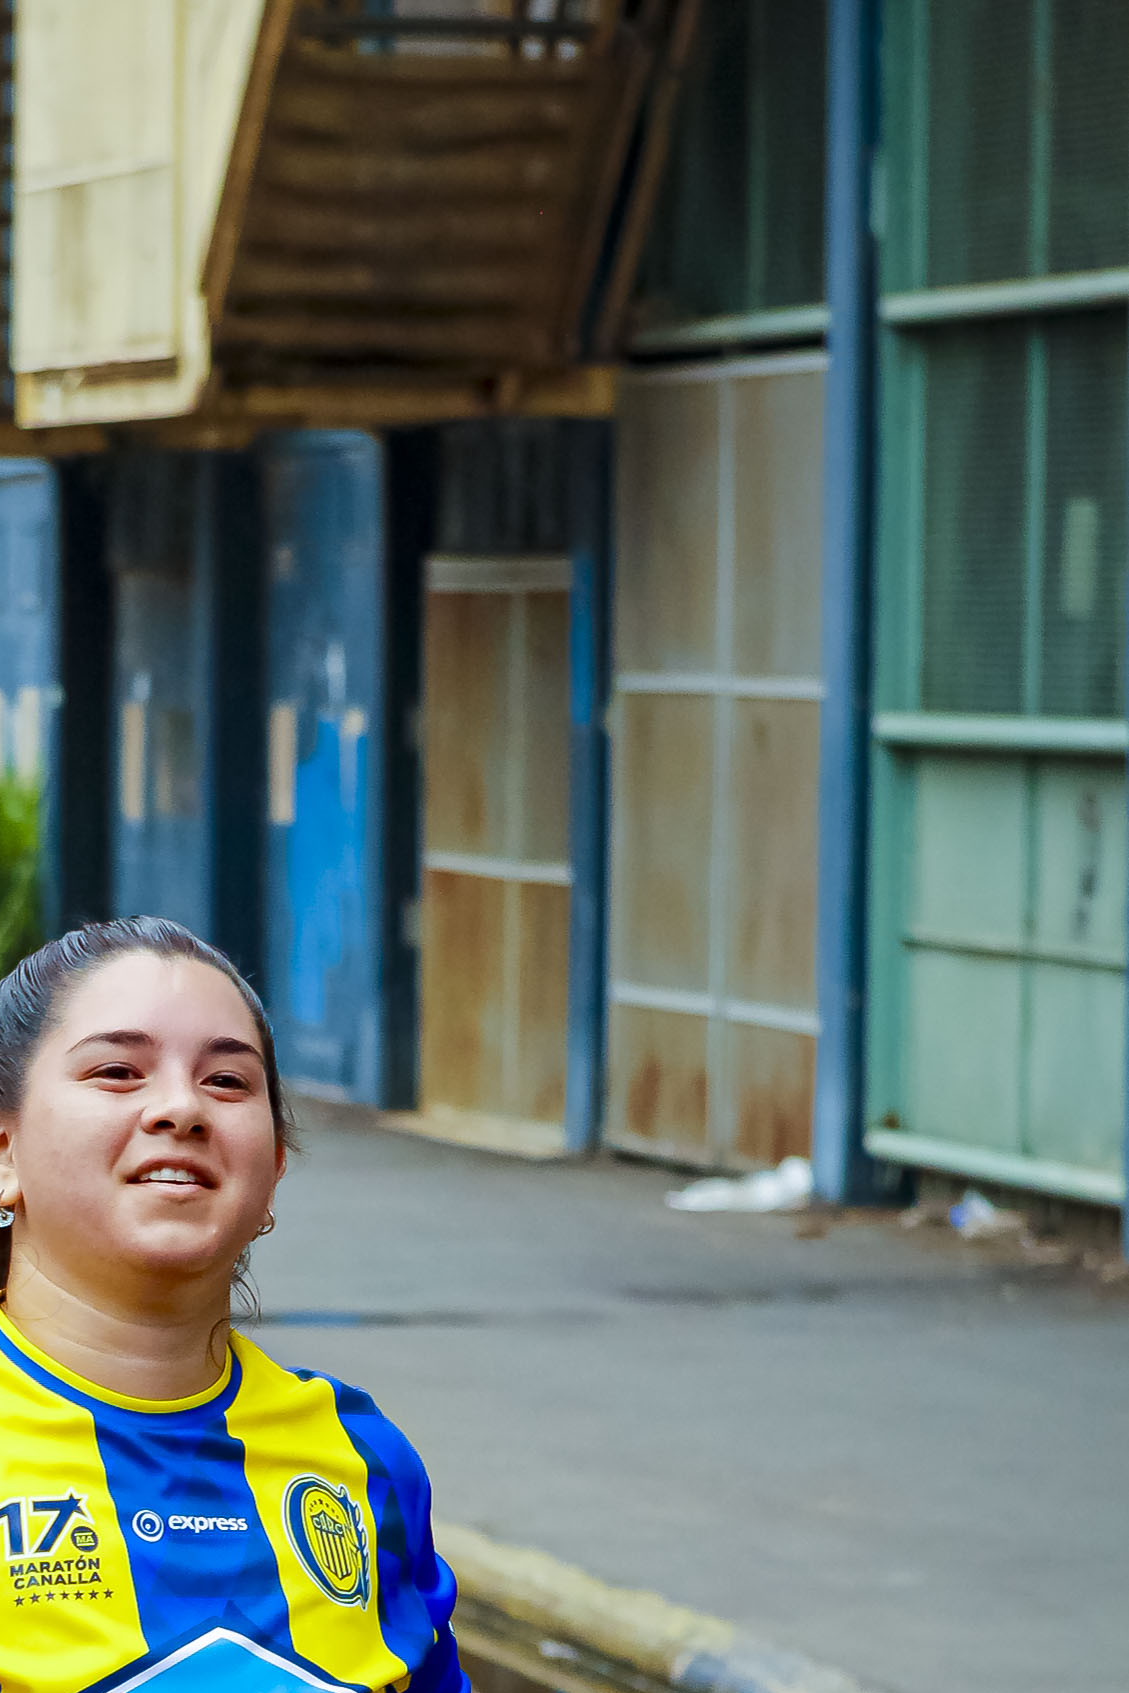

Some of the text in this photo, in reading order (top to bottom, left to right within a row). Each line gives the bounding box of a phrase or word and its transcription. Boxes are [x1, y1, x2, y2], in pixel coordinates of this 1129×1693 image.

[168, 1514, 249, 1534] express
[9, 1555, 101, 1577] MARATÓN
[13, 1571, 102, 1590] CANALLA
